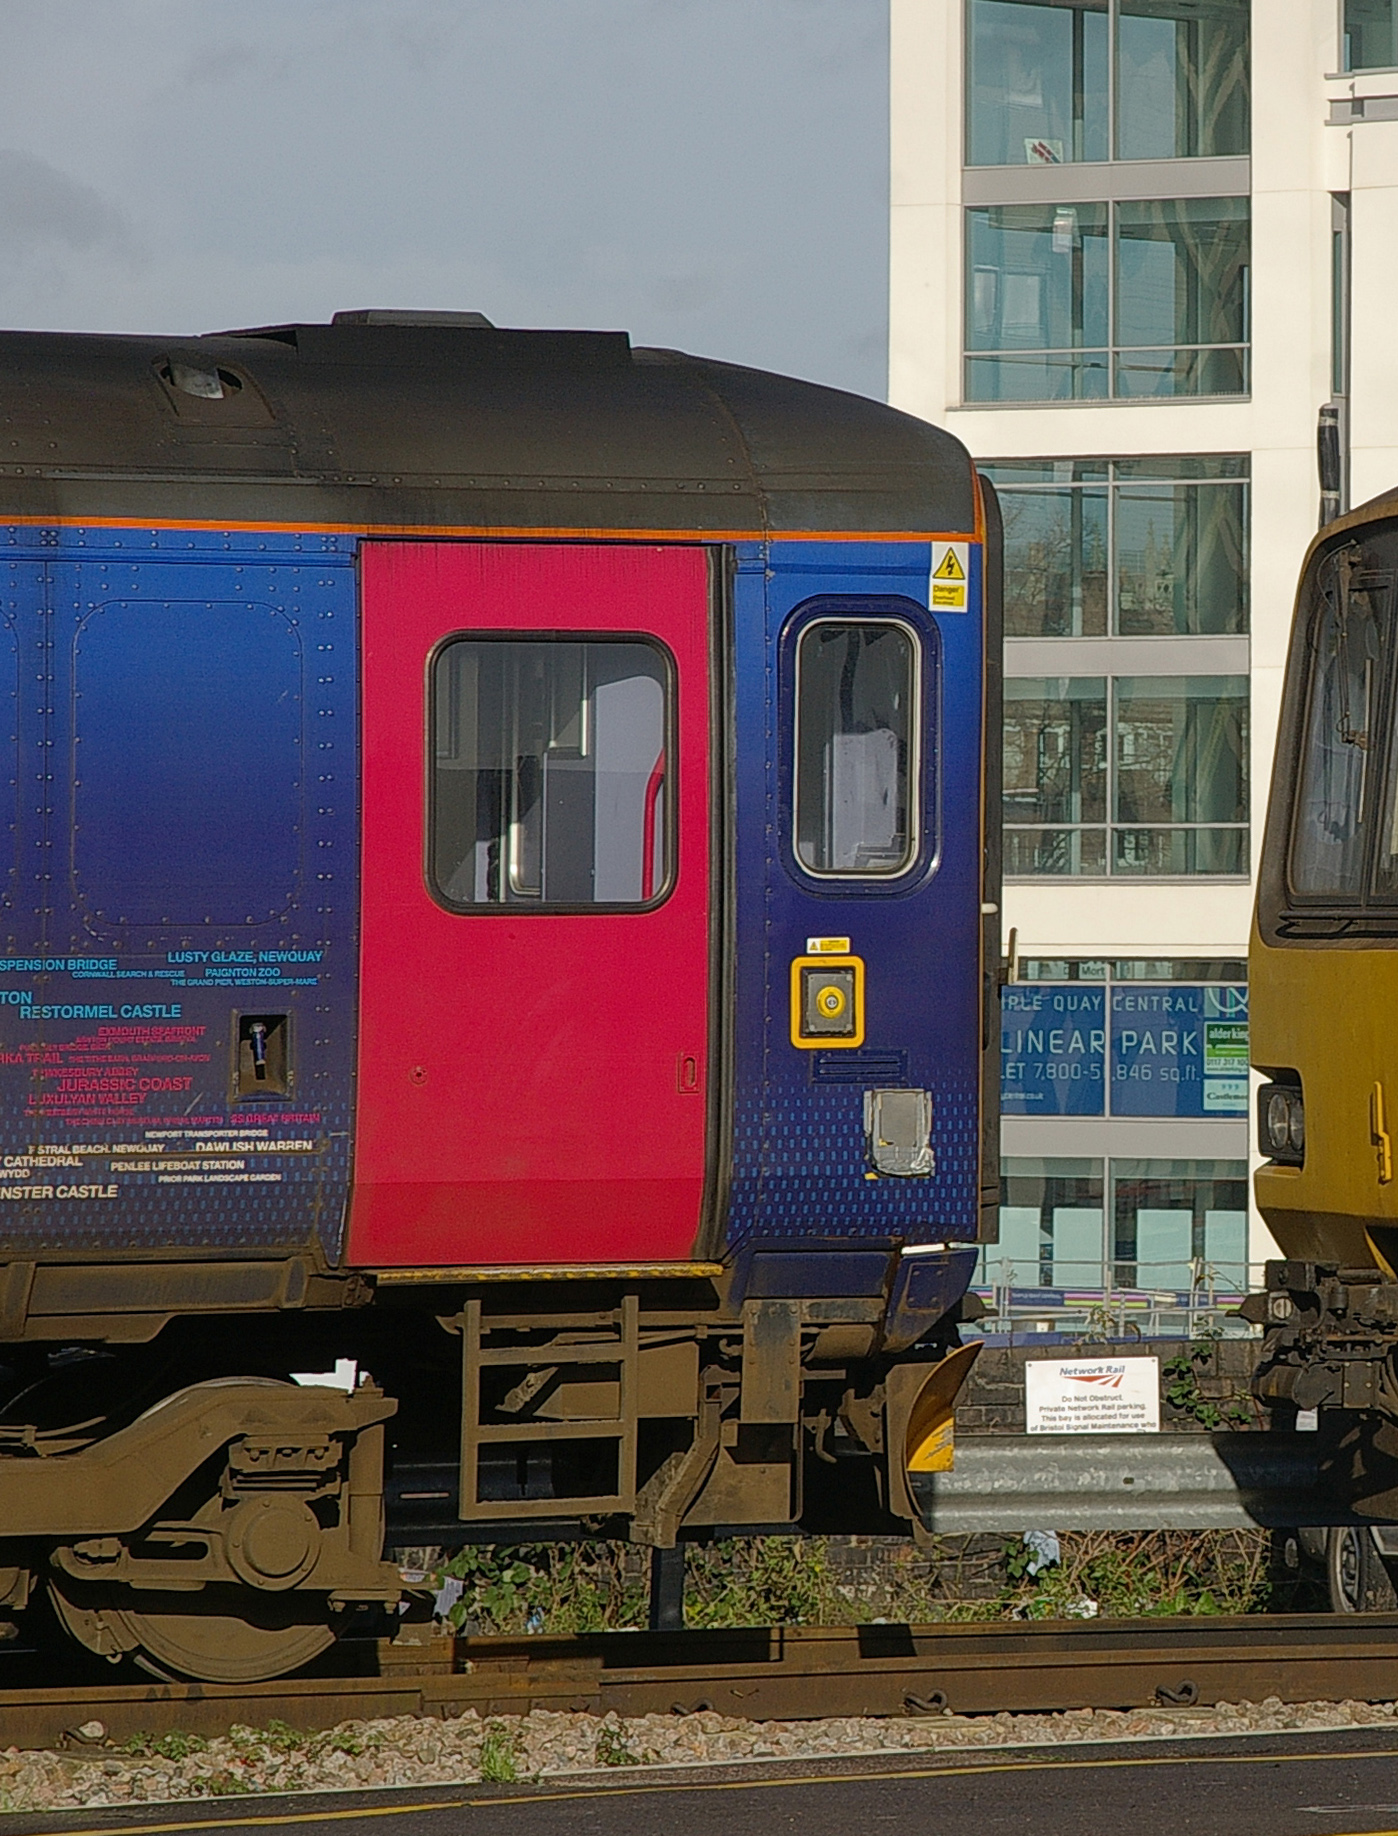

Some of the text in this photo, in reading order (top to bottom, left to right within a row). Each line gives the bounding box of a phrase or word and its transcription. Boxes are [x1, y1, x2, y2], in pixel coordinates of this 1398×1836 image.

[167, 950, 323, 964] LUSTY GLAZE, NEWQUAY
[67, 959, 117, 970] BRIDGE
[205, 968, 281, 977] PAIGNTON ZOO
[171, 978, 186, 986] THE
[1002, 996, 1198, 1012] PLE QUAY CENTRAL
[20, 1004, 181, 1019] RESTORMEL CASTLE
[1121, 1030, 1197, 1055] PARK
[1206, 1058, 1223, 1066] 0117
[1224, 1058, 1236, 1066] 317
[32, 1067, 103, 1077] TWKESBURY
[1001, 1062, 1026, 1080] ET
[1160, 1064, 1200, 1083] sq.ft.
[57, 1077, 193, 1092] JURASSIC COAST
[98, 1093, 147, 1105] VALLEY
[28, 1145, 71, 1154] FSTRAL
[112, 1144, 165, 1154] NEWQUAY
[195, 1140, 313, 1152] DAWLISH WARREN
[4, 1156, 83, 1167] CATHEDRAL
[111, 1160, 245, 1171] PENLEE LIFEBOAT STATION
[183, 1175, 203, 1183] PARK
[204, 1174, 249, 1182] LANDSCAPE
[56, 1185, 118, 1199] CASTLE
[1059, 1365, 1125, 1376] Network Rail
[1058, 1414, 1072, 1423] bay
[1082, 1413, 1117, 1421] allocated
[1066, 1423, 1089, 1432] Signal
[1091, 1422, 1138, 1430] Maintenance
